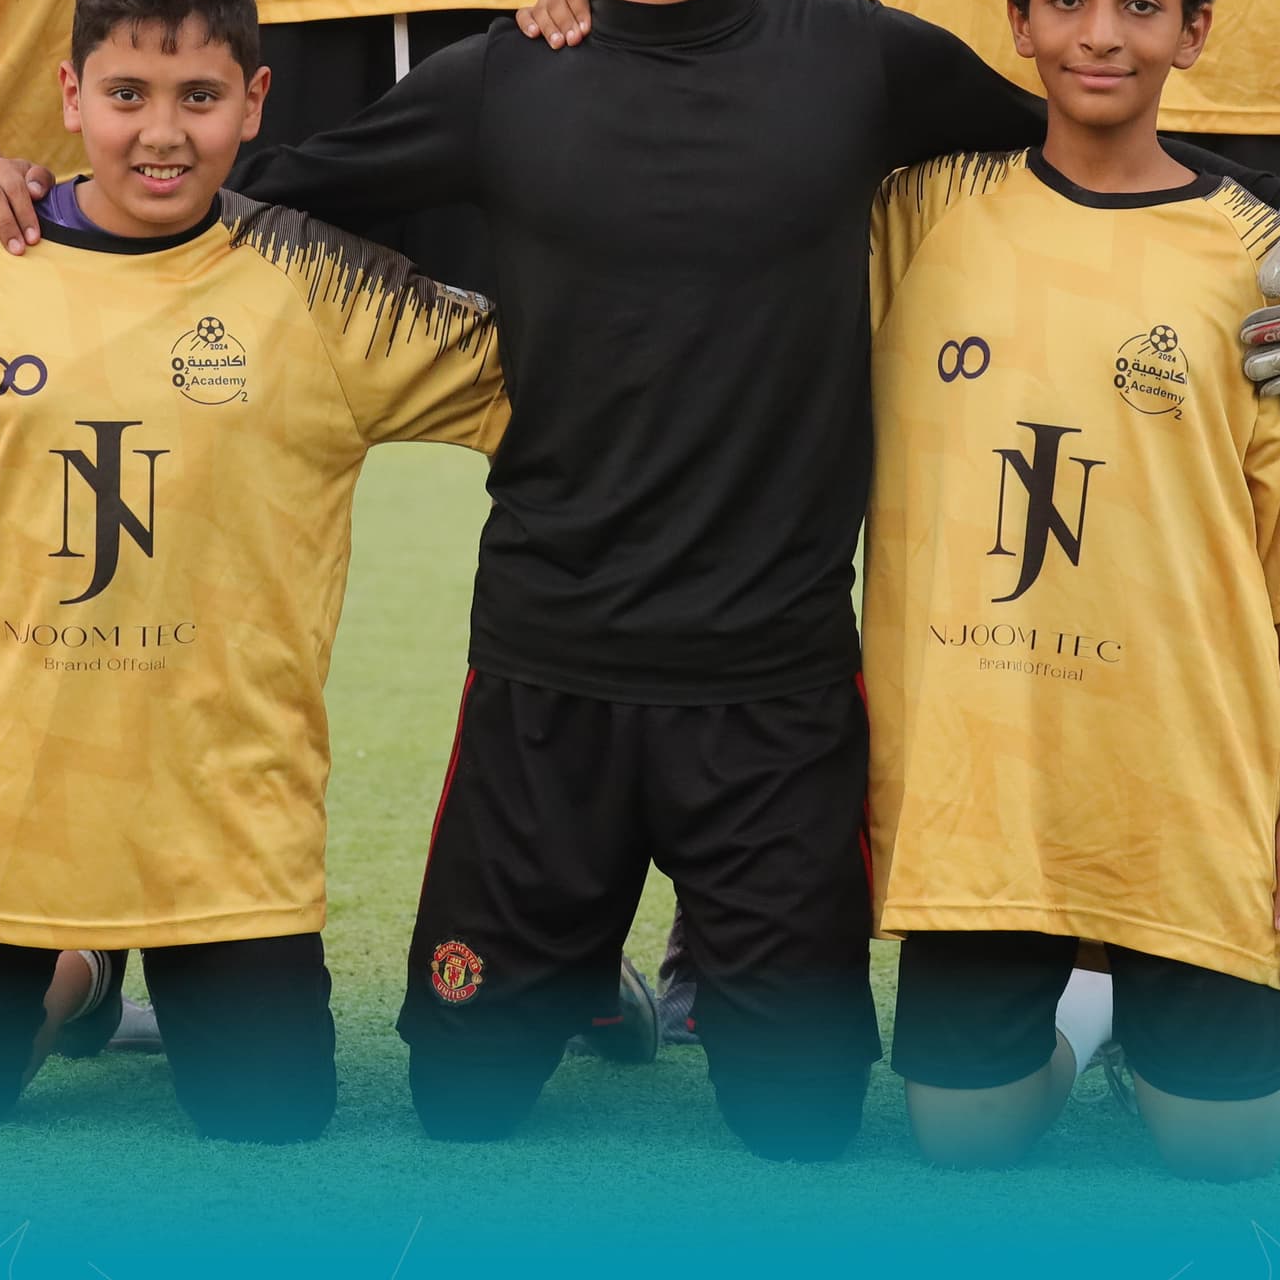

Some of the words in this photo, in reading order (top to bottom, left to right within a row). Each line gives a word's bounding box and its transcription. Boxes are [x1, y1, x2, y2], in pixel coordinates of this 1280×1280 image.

[1158, 352, 1176, 363] 2024
[191, 375, 247, 388] Academy
[241, 391, 248, 402] 2
[1130, 380, 1185, 405] Academy
[1174, 409, 1183, 420] 2
[4, 620, 120, 648] NJOOM
[134, 622, 196, 647] TEC
[1052, 631, 1121, 663] TEC
[44, 656, 101, 671] Brand
[437, 983, 467, 999] UNITED
